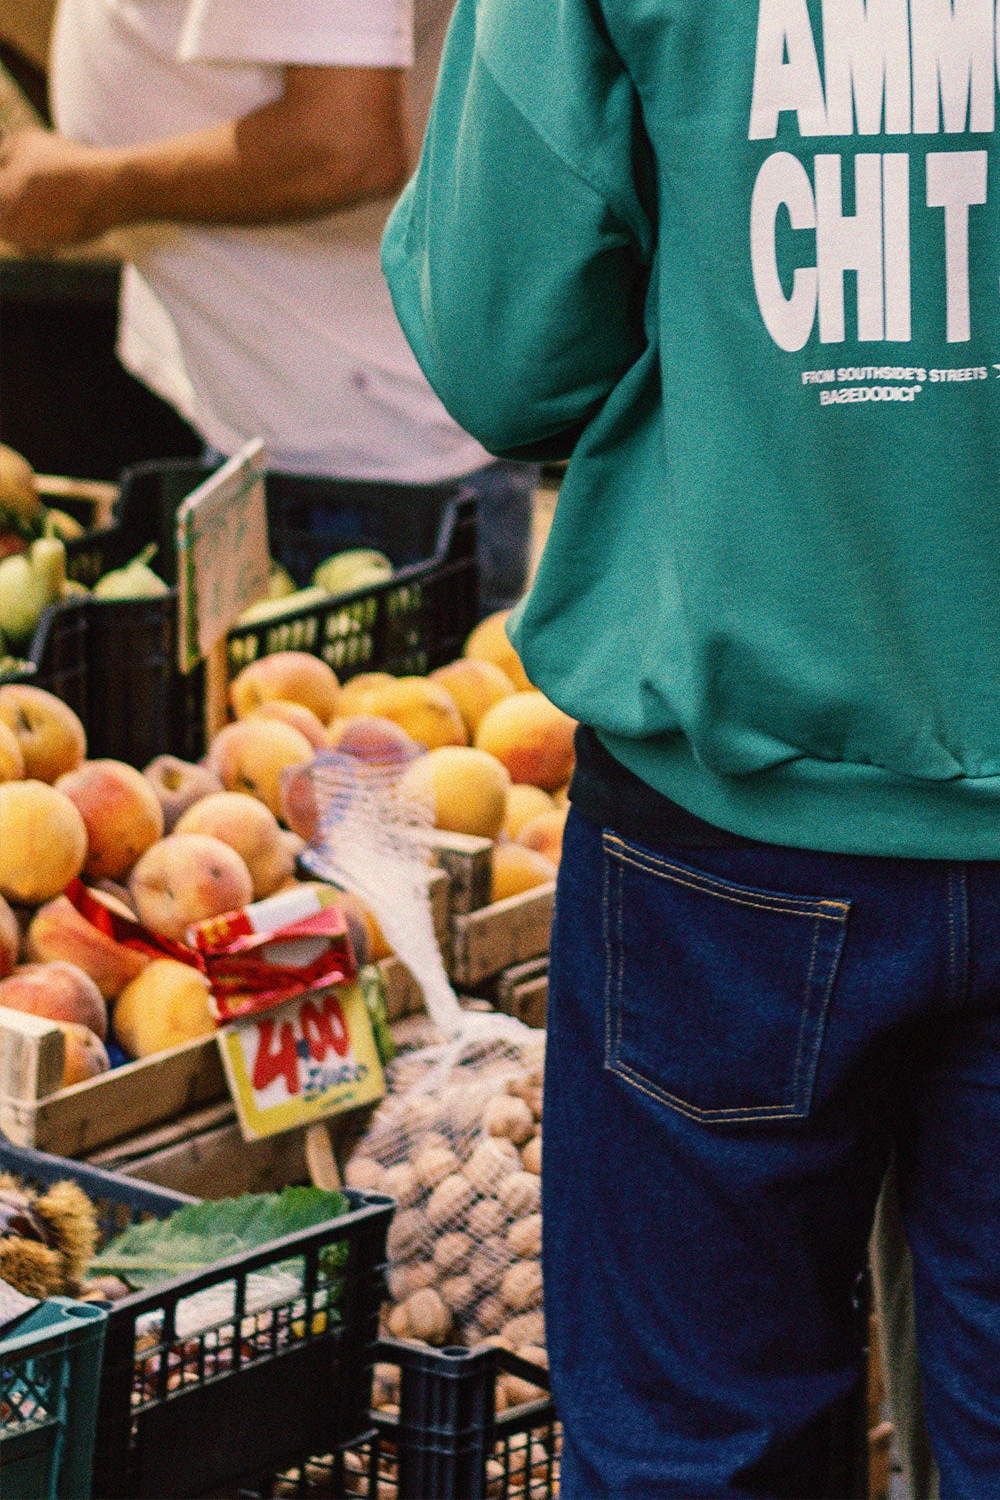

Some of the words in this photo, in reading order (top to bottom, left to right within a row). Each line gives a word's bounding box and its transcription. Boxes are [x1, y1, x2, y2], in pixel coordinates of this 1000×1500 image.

[750, 151, 912, 352] CHI
[802, 369, 836, 385] FROM
[837, 366, 927, 382] SOUTHSIDE'S
[928, 366, 988, 382] STREETS
